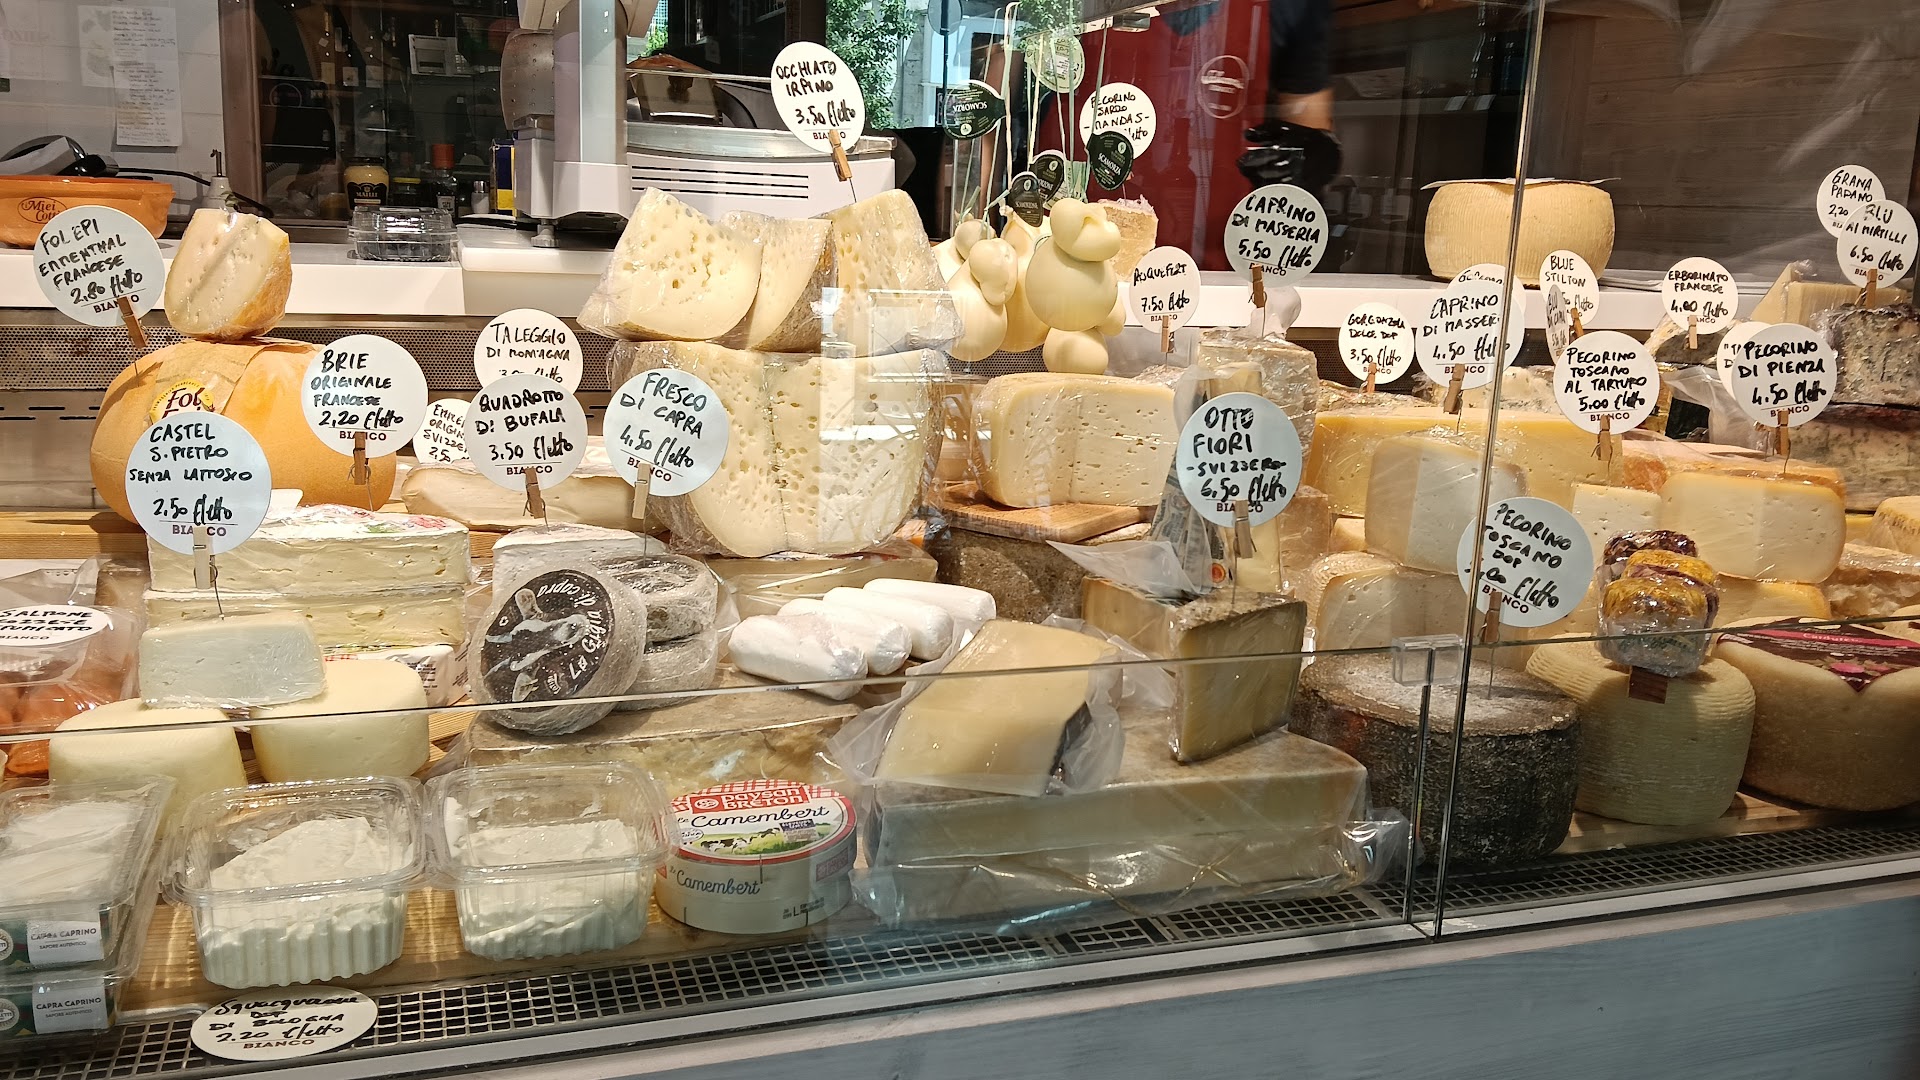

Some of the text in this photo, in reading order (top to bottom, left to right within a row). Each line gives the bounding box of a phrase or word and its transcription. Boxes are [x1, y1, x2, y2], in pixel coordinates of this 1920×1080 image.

[776, 61, 837, 79] OCCHIATO
[786, 78, 834, 97] IRPINO
[953, 101, 988, 112] SCAMORZA
[1097, 105, 1128, 117] SARDO
[813, 131, 846, 140] BIAO
[1832, 169, 1873, 191] GRANA
[1831, 184, 1873, 203] PADANO
[1245, 194, 1316, 223] CAPRINO
[1232, 213, 1320, 244] DI MASSERIA
[1846, 222, 1859, 234] AI
[1861, 225, 1908, 245] MIRTILLI
[40, 231, 71, 256] FOL
[1238, 239, 1271, 259] 5,50
[38, 234, 126, 277] EMMENTHAL
[1550, 255, 1575, 271] BLUE
[53, 254, 125, 291] FRANCESE
[1249, 262, 1287, 276] ANCO
[1668, 270, 1729, 283] ERBORINATO
[1854, 268, 1884, 281] BIAO
[1545, 272, 1587, 287] STILTON
[1674, 282, 1724, 294] FRANCESE
[70, 281, 106, 304] 2,80
[93, 294, 140, 313] BIANO
[1430, 294, 1499, 319] CAPRINO
[490, 323, 566, 345] TALEGGIO
[1422, 325, 1438, 337] DI
[486, 346, 501, 358] DI
[1350, 348, 1374, 364] 3,50
[1433, 341, 1465, 361] 4,50
[1566, 347, 1636, 365] PECORINO
[1743, 340, 1818, 360] PECORINO
[322, 350, 369, 372] BRIE
[1444, 365, 1486, 374] BINCO
[1738, 358, 1826, 378] DI PIENZA
[1363, 367, 1392, 375] BNCO
[1570, 365, 1630, 378] TOSCANO
[311, 375, 392, 390] ORIGINALE
[642, 372, 707, 412] FRESCO
[1564, 376, 1648, 394] AL TARTUFO
[314, 393, 381, 407] FRANCESE
[479, 388, 564, 413] QUADROTTO
[319, 411, 359, 428] 2,20
[620, 393, 704, 440] DI CAPRA
[1204, 406, 1254, 432] OTTO
[1590, 412, 1630, 422] BINCO
[1770, 405, 1810, 417] BNCO
[476, 407, 566, 435] DI BUFALA
[150, 423, 216, 443] CASTEL
[339, 431, 386, 441] BICO
[620, 424, 652, 451] 4,50
[489, 442, 523, 461] 3,50
[1193, 432, 1253, 458] FIORI
[129, 468, 171, 484] SENZA
[506, 465, 553, 475] BIACO
[627, 457, 672, 482] BINCO
[1200, 477, 1240, 502] 6,50
[153, 497, 188, 519] 2,50
[1216, 503, 1264, 513] BIACO
[172, 525, 227, 537] BIACO
[1494, 503, 1572, 551] PECORINO
[1492, 550, 1522, 568] DOP
[537, 579, 580, 598] capra
[574, 593, 599, 608] di
[1482, 584, 1530, 614] BNCO
[569, 655, 588, 680] La
[691, 806, 830, 828] Camembert
[676, 869, 761, 895] Camembert
[60, 927, 97, 937] CAPRINO
[36, 997, 102, 1010] CAPRA CAPRINO
[208, 1013, 345, 1031] DI BOLOGNA
[242, 1038, 315, 1049] BIANCO
